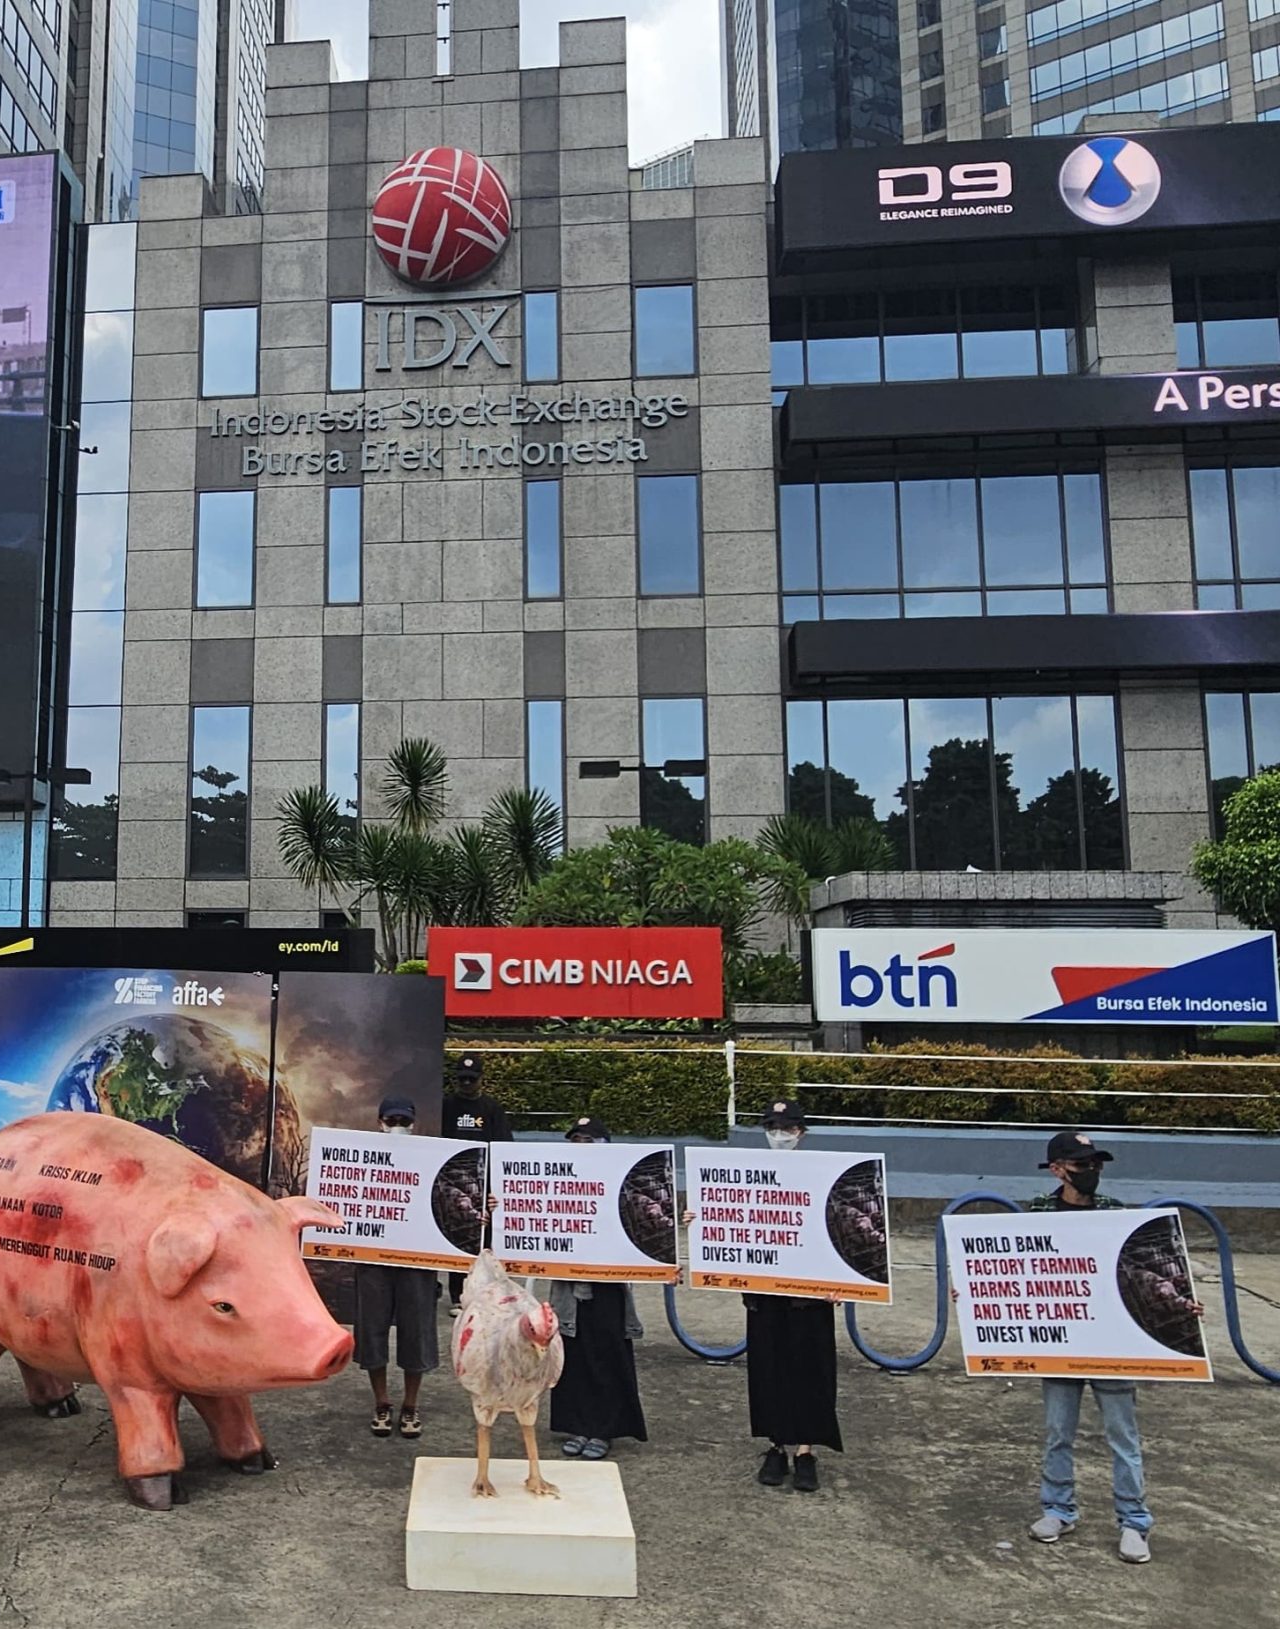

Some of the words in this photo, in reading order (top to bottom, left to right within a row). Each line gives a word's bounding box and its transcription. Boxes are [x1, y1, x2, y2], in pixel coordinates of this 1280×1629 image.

[879, 161, 1012, 205] D9
[880, 208, 939, 221] ELEGANCE
[941, 204, 1013, 217] REIMAGINED
[375, 305, 511, 372] IDX
[1154, 377, 1189, 412] A
[209, 403, 387, 437] Indonesia
[400, 394, 498, 430] Stock
[510, 391, 689, 428] Exchange
[242, 446, 348, 477] Bursa
[359, 440, 444, 472] Efek
[460, 432, 649, 470] Indonesia
[499, 958, 585, 985] CIMB
[591, 959, 693, 986] NIAGA
[839, 948, 958, 1008] btn
[172, 980, 208, 1006] affa
[1096, 996, 1144, 1010] Bursa
[1148, 996, 1181, 1011] Efek
[1185, 998, 1267, 1012] Indonesia
[457, 1114, 475, 1127] affa
[321, 1147, 359, 1162] WORLD
[363, 1150, 395, 1167] BANK,
[39, 1164, 72, 1180] KRISIS
[71, 1169, 103, 1186] IKLIM
[320, 1165, 367, 1181] FACTORY
[370, 1169, 420, 1186] FARMING
[502, 1161, 540, 1176] WORLD
[544, 1162, 577, 1178] BANK,
[700, 1168, 741, 1184] WORLD
[745, 1170, 781, 1187] BANK,
[319, 1183, 358, 1199] HARMS
[361, 1187, 411, 1204] ANIMALS
[502, 1179, 551, 1195] FACTORY
[554, 1181, 605, 1196] FARMING
[701, 1187, 752, 1204] FACTORY
[756, 1190, 810, 1206] FARMING
[31, 1201, 64, 1220] KOTOR
[343, 1202, 362, 1218] THE
[366, 1205, 408, 1221] PLANET.
[503, 1198, 542, 1213] HARMS
[547, 1200, 597, 1215] ANIMALS
[701, 1206, 744, 1223] HARMS
[748, 1209, 803, 1226] ANIMALS
[356, 1223, 385, 1238] NOW!
[504, 1217, 525, 1232] AND
[529, 1218, 548, 1232] THE
[552, 1219, 597, 1234] PLANET.
[504, 1235, 540, 1251] DIVEST
[544, 1237, 573, 1252] NOW!
[702, 1227, 725, 1242] AND
[729, 1228, 750, 1244] THE
[755, 1230, 803, 1247] PLANET.
[961, 1237, 1011, 1254] WORLD
[1015, 1235, 1059, 1254] BANK,
[54, 1247, 87, 1266] RUANG
[88, 1253, 116, 1272] HIDUP
[702, 1246, 742, 1263] DIVEST
[746, 1249, 779, 1265] NOW!
[966, 1259, 1026, 1276] FACTORY
[1031, 1257, 1098, 1274] FARMING
[969, 1281, 1021, 1298] HARMS
[1026, 1280, 1091, 1298] ANIMALS
[974, 1304, 1001, 1320] AND
[1005, 1304, 1031, 1320] THE
[1037, 1303, 1095, 1321] PLANET.
[976, 1326, 1024, 1343] DIVEST
[1029, 1326, 1069, 1344] NOW!
